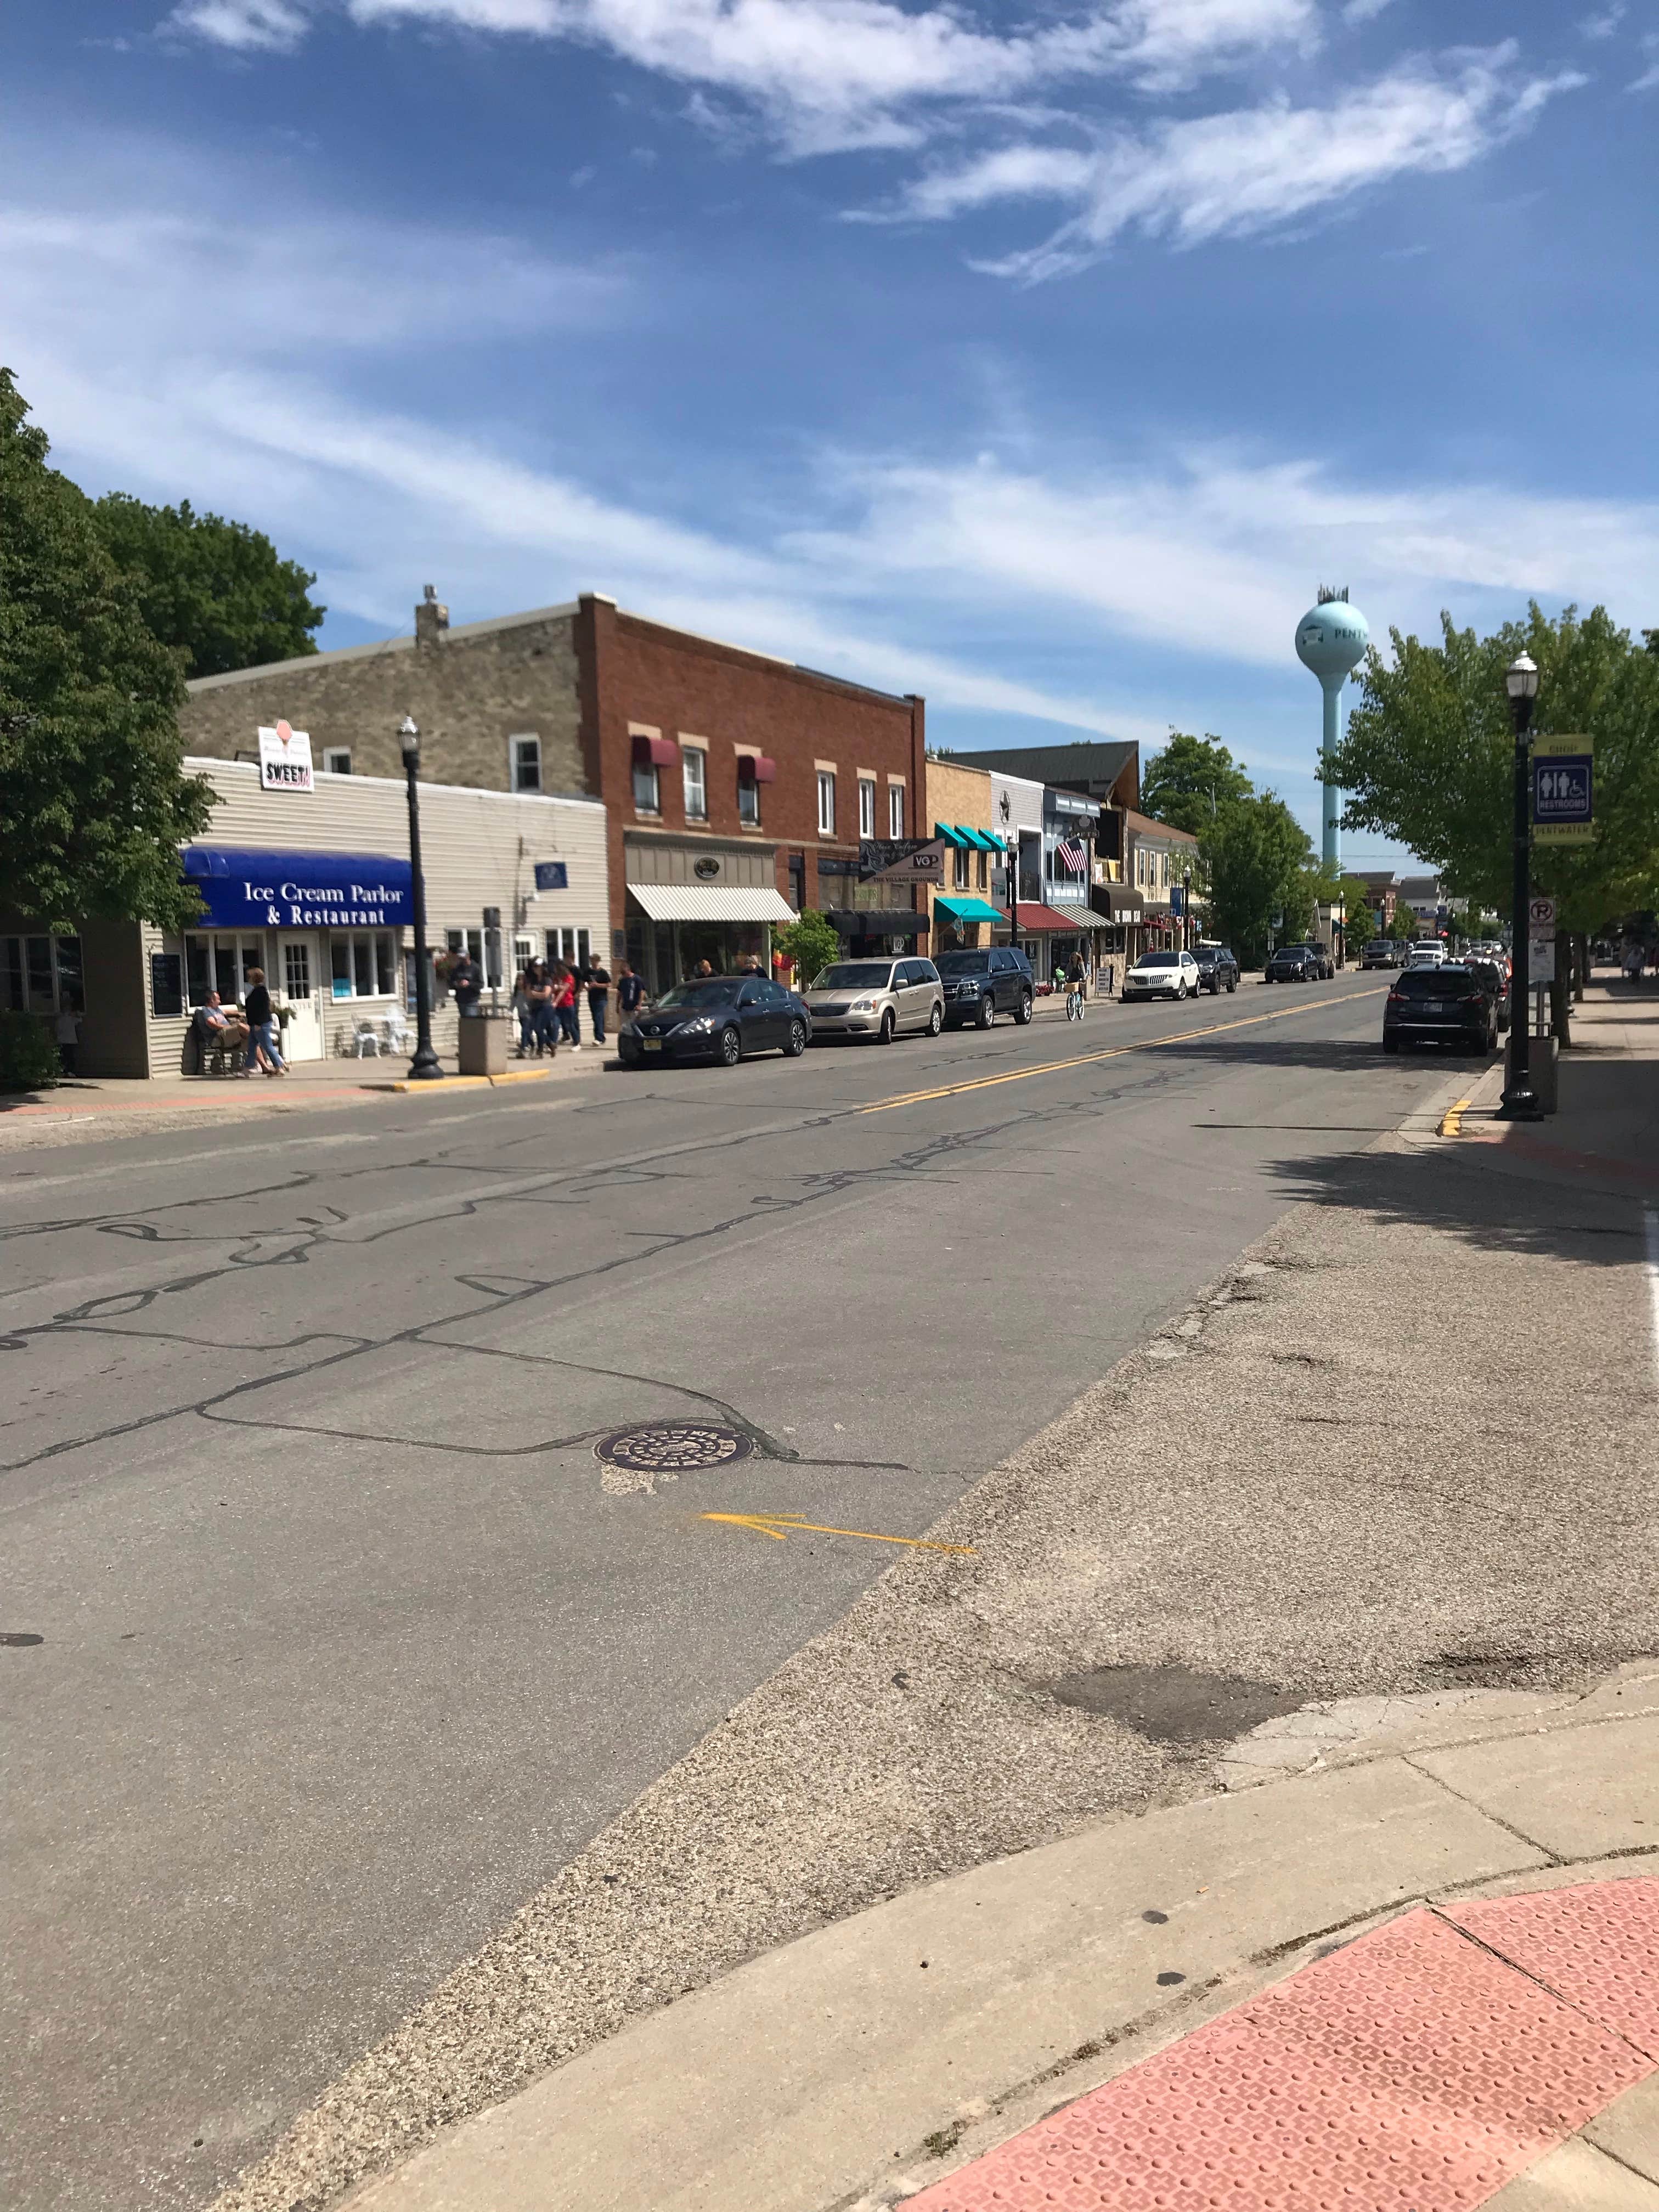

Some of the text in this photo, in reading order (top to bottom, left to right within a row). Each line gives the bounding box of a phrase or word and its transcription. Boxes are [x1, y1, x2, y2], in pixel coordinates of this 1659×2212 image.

[1541, 798, 1585, 809] RESTROOMS
[243, 882, 404, 904] Ice Cream Parlor
[268, 905, 385, 925] & Restaurant
